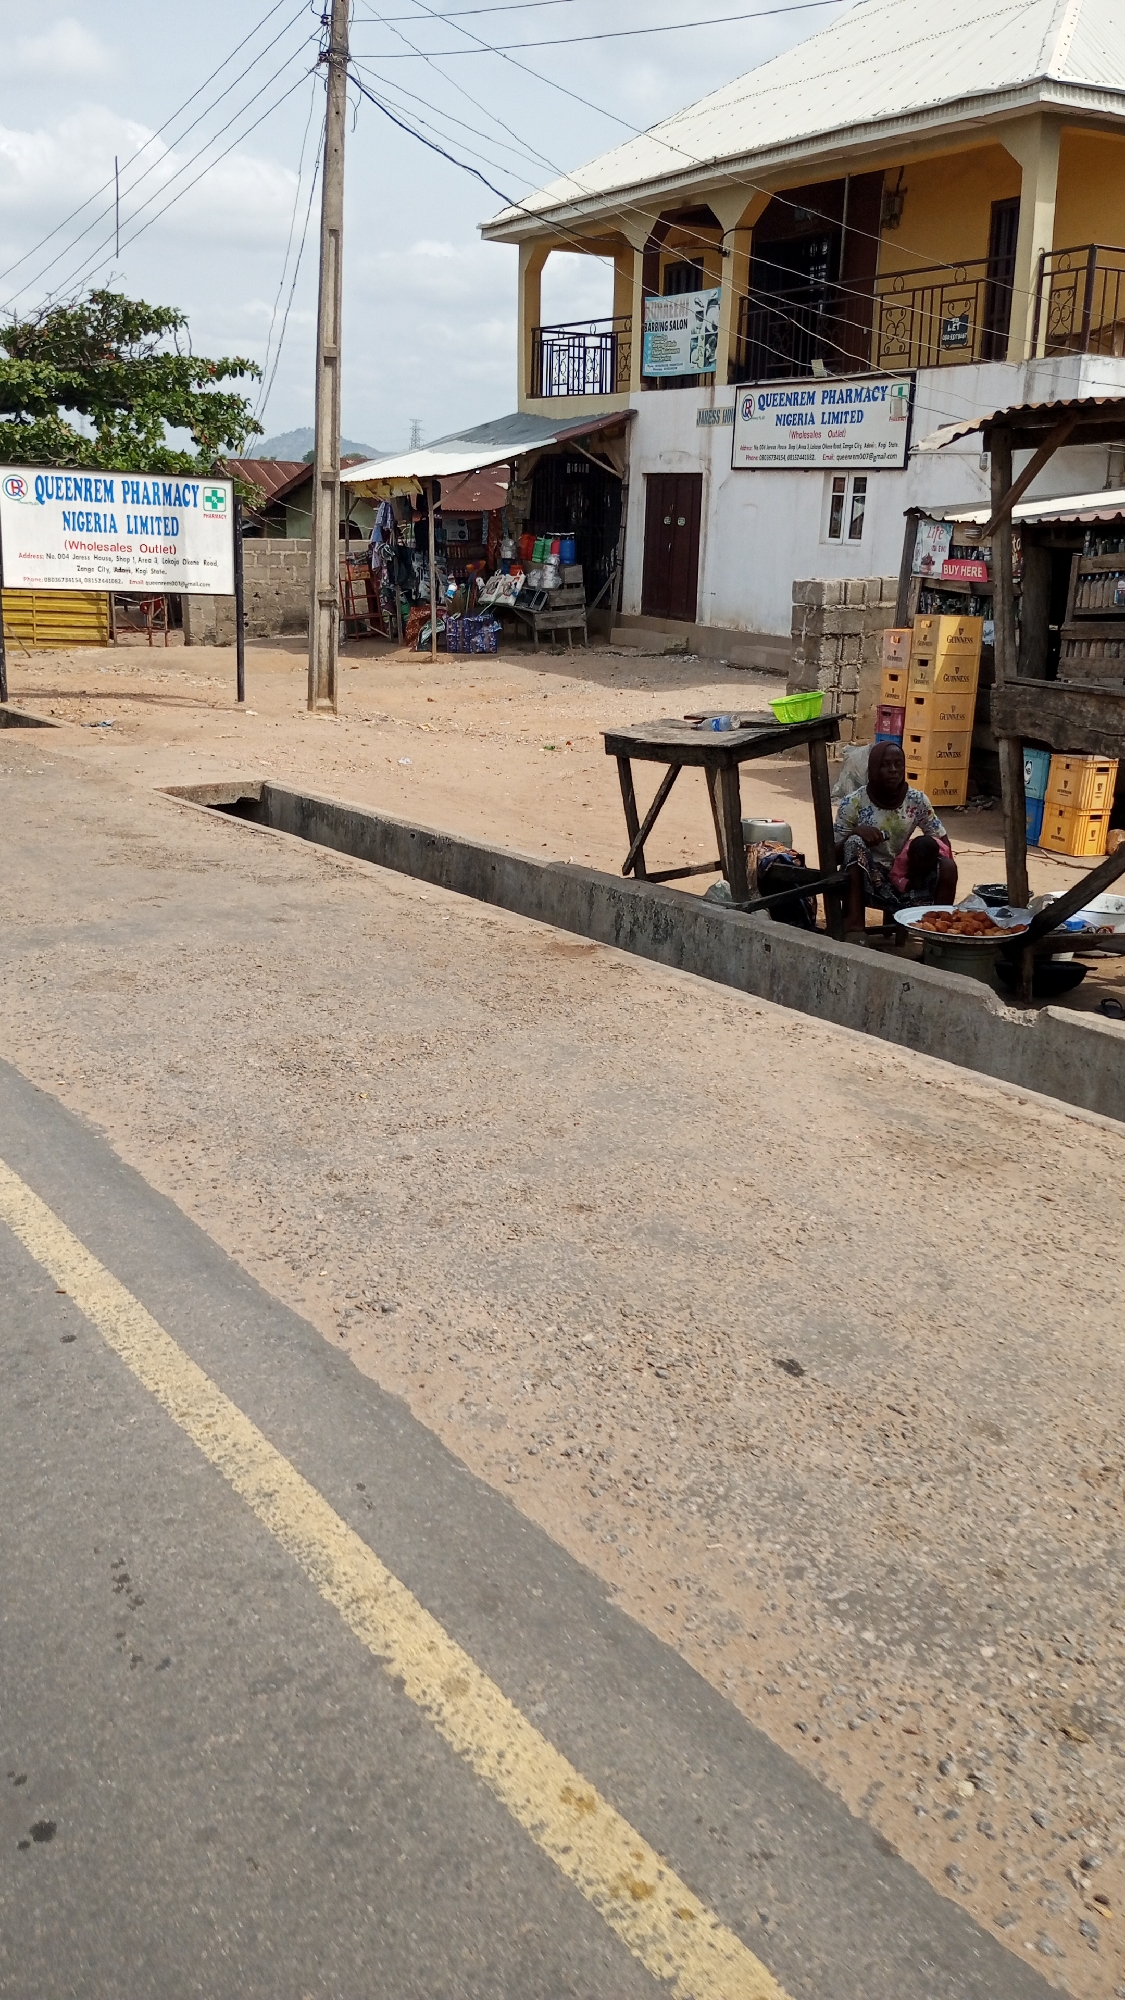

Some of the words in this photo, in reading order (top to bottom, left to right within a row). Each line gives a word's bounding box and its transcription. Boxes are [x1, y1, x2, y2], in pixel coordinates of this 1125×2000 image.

[644, 321, 669, 333] BARBING
[669, 318, 688, 331] SALON
[947, 323, 961, 332] LET
[757, 390, 817, 411] QUEENREM
[821, 385, 888, 405] PHARMACY
[696, 409, 721, 426] JARESS
[775, 412, 816, 427] NIGERIA
[821, 410, 864, 425] LIMITED
[35, 475, 115, 505] QUEENREM
[121, 480, 199, 508] PHARMACY
[62, 510, 118, 534] NIGERIA
[126, 514, 179, 537] LIMITED
[926, 525, 945, 544] Life
[64, 539, 132, 553] (Wholesales
[140, 543, 177, 555] Outlet)
[116, 555, 130, 564] Shop
[97, 565, 111, 574] City,
[135, 567, 148, 575] Kogi
[943, 564, 960, 576] BUY
[960, 565, 983, 578] HERE
[947, 634, 974, 644] GUINNESS
[943, 673, 970, 683] GUINNESS
[940, 712, 965, 721] GUINNESS
[936, 750, 961, 759] GUINNESS
[932, 788, 958, 796] GUINNESS
